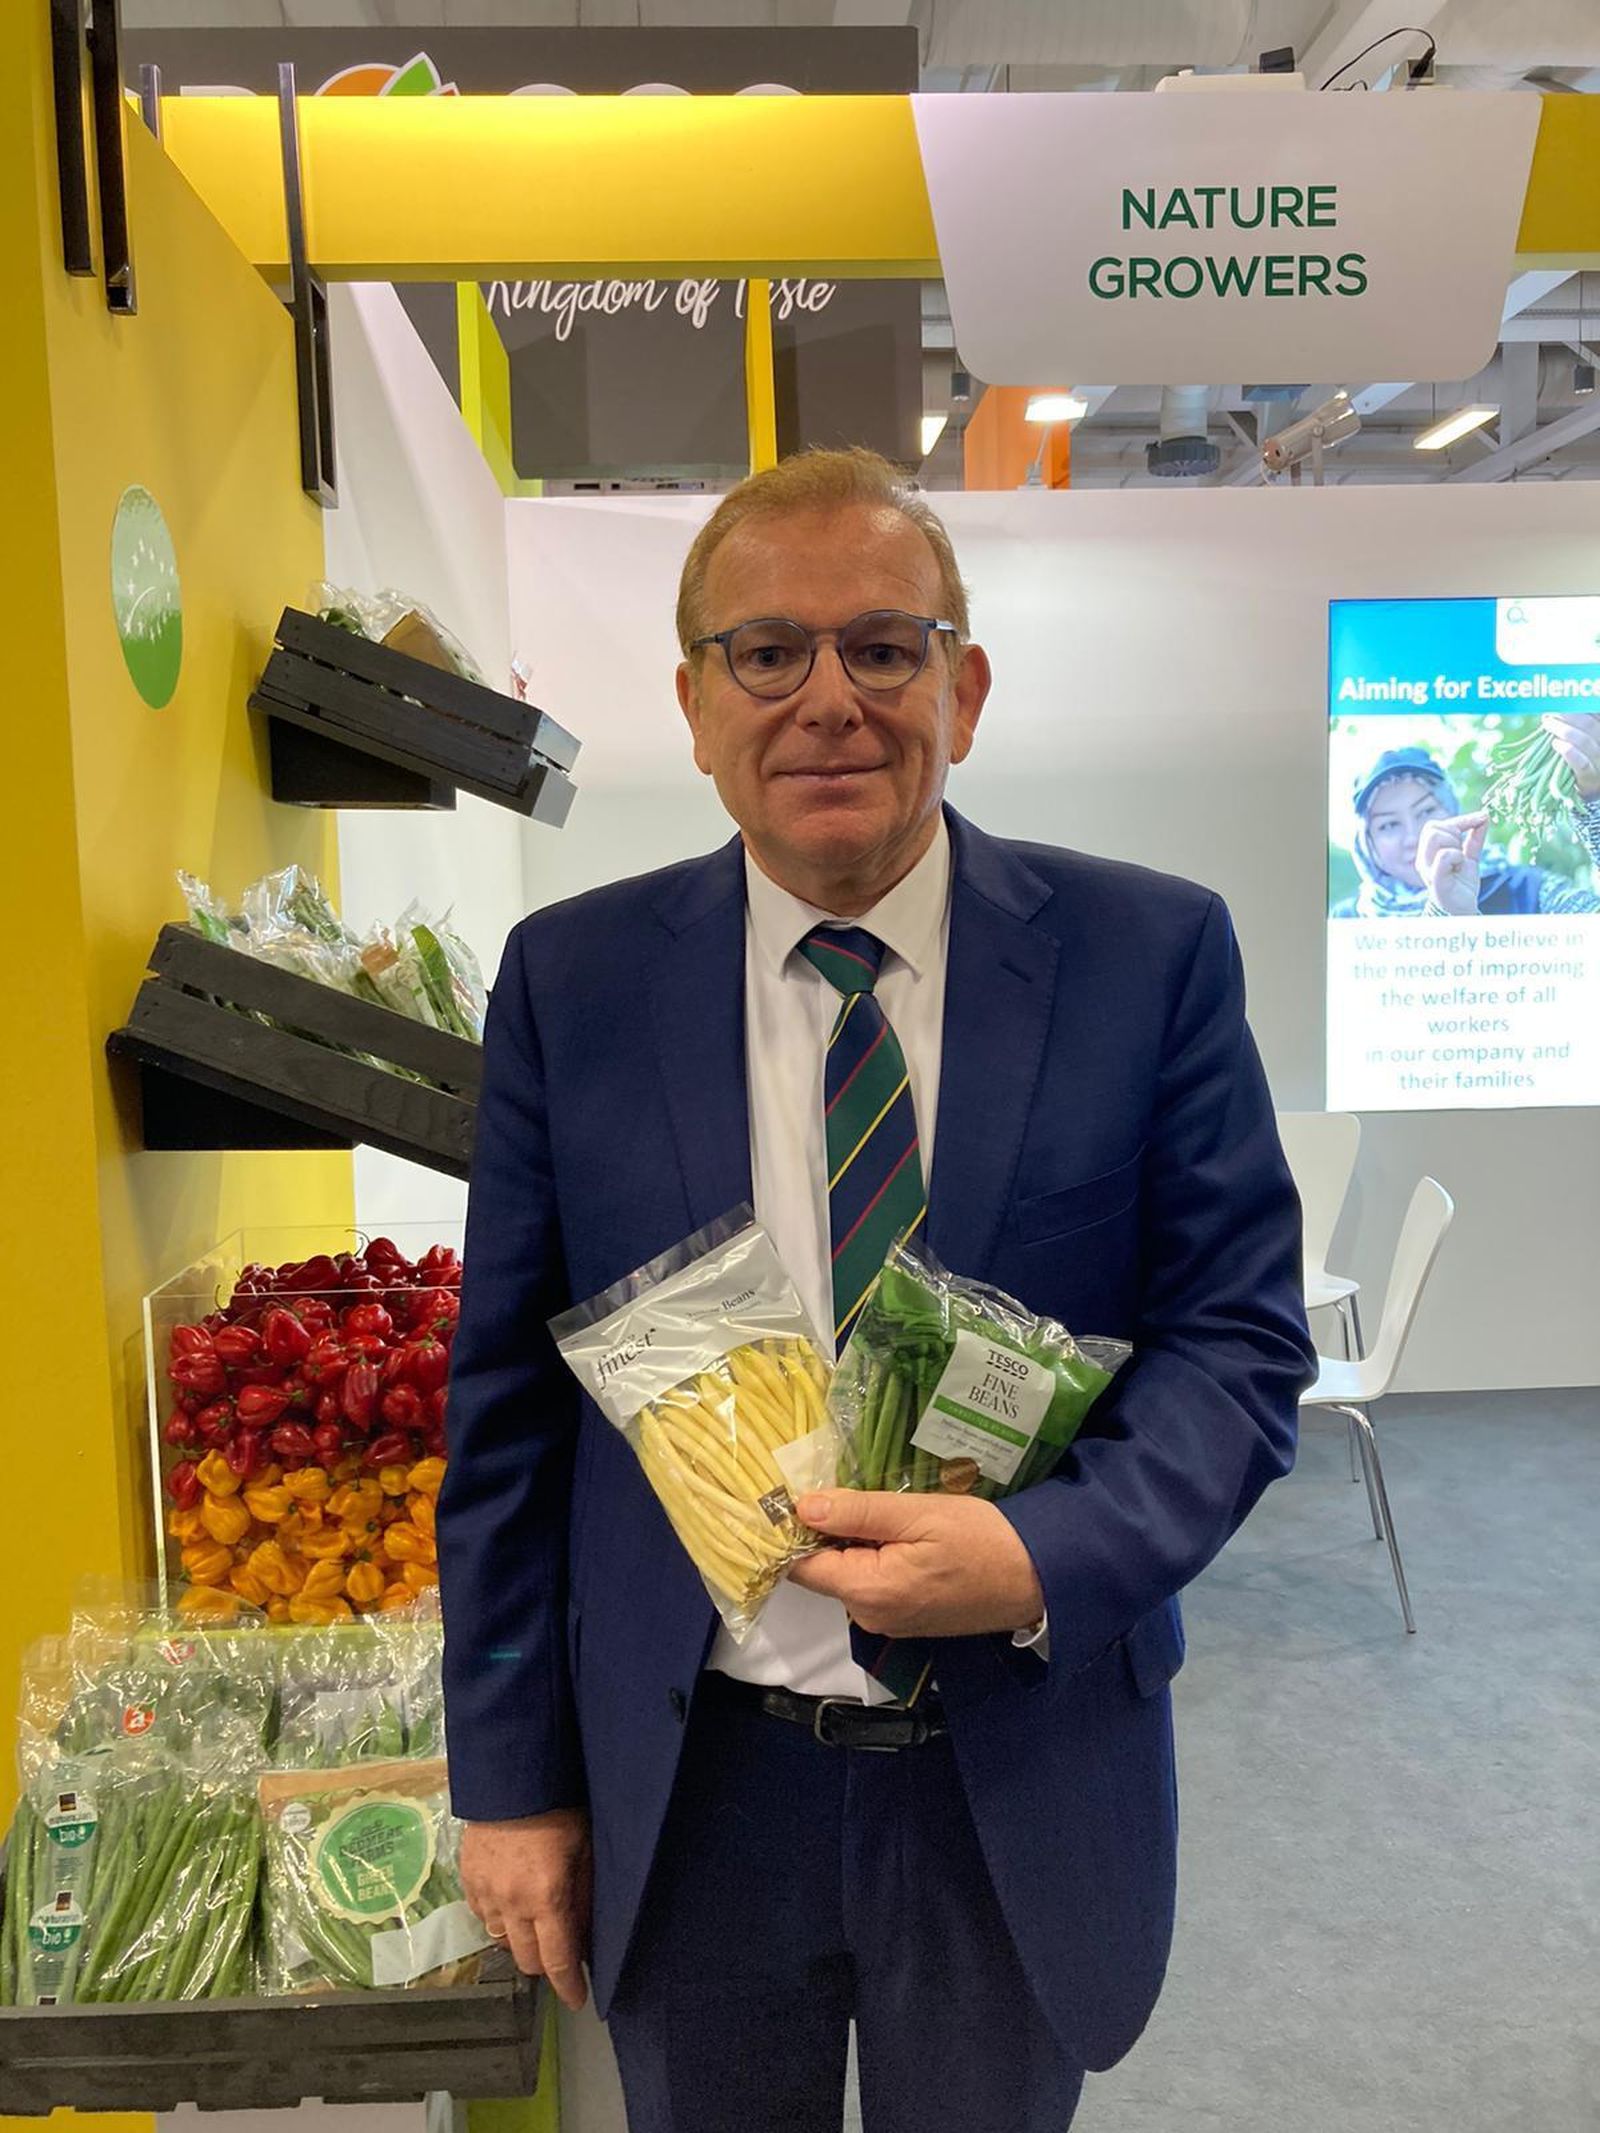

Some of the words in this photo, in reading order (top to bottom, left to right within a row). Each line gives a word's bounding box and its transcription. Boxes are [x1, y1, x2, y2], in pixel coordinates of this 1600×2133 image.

[1121, 185, 1338, 230] NATURE
[1088, 252, 1368, 299] GROWERS
[1339, 676, 1429, 705] Aiming
[1433, 674, 1472, 699] for
[1355, 934, 1388, 951] We
[1395, 931, 1477, 952] strongly
[1485, 930, 1558, 948] believe
[1565, 929, 1584, 946] in
[1354, 962, 1388, 979] the
[1395, 961, 1446, 977] need
[1453, 959, 1474, 976] of
[1480, 960, 1584, 979] improving
[1381, 988, 1415, 1006] the
[1422, 987, 1499, 1005] welfare
[1506, 986, 1526, 1003] of
[1533, 986, 1557, 1003] all
[1428, 1015, 1510, 1034] workers
[1366, 1046, 1384, 1063] in
[1390, 1048, 1425, 1062] our
[1432, 1046, 1525, 1064] company
[1532, 1042, 1571, 1059] and
[1400, 1072, 1449, 1090] their
[1455, 1071, 1535, 1089] families
[988, 1348, 1030, 1377] TESCO
[982, 1372, 1020, 1401] FINE
[968, 1385, 1020, 1420] BEANS
